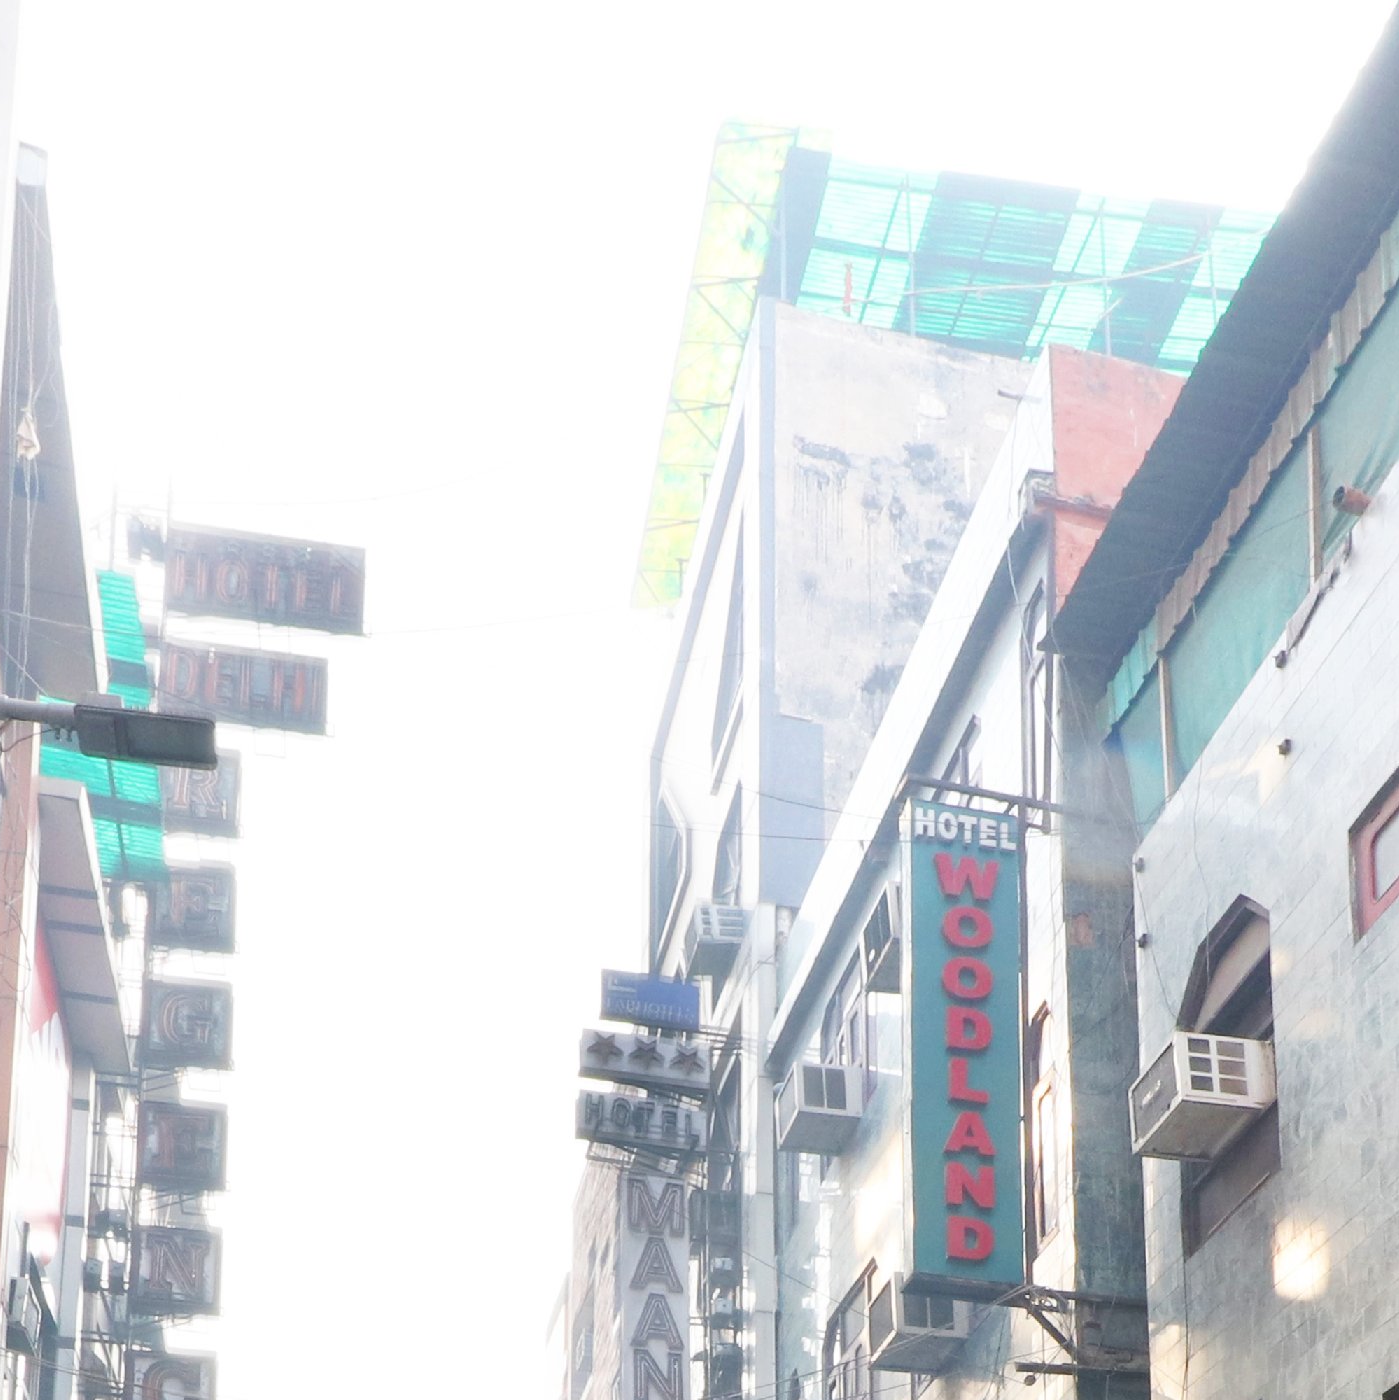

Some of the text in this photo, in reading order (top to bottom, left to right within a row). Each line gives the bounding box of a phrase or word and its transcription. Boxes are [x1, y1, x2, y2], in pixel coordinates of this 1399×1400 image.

[170, 550, 357, 617] HOTEL
[163, 646, 324, 714] DELHI
[914, 807, 1017, 850] HOTEL
[933, 851, 998, 1263] WOODLAND
[585, 1093, 699, 1147] HOTEL
